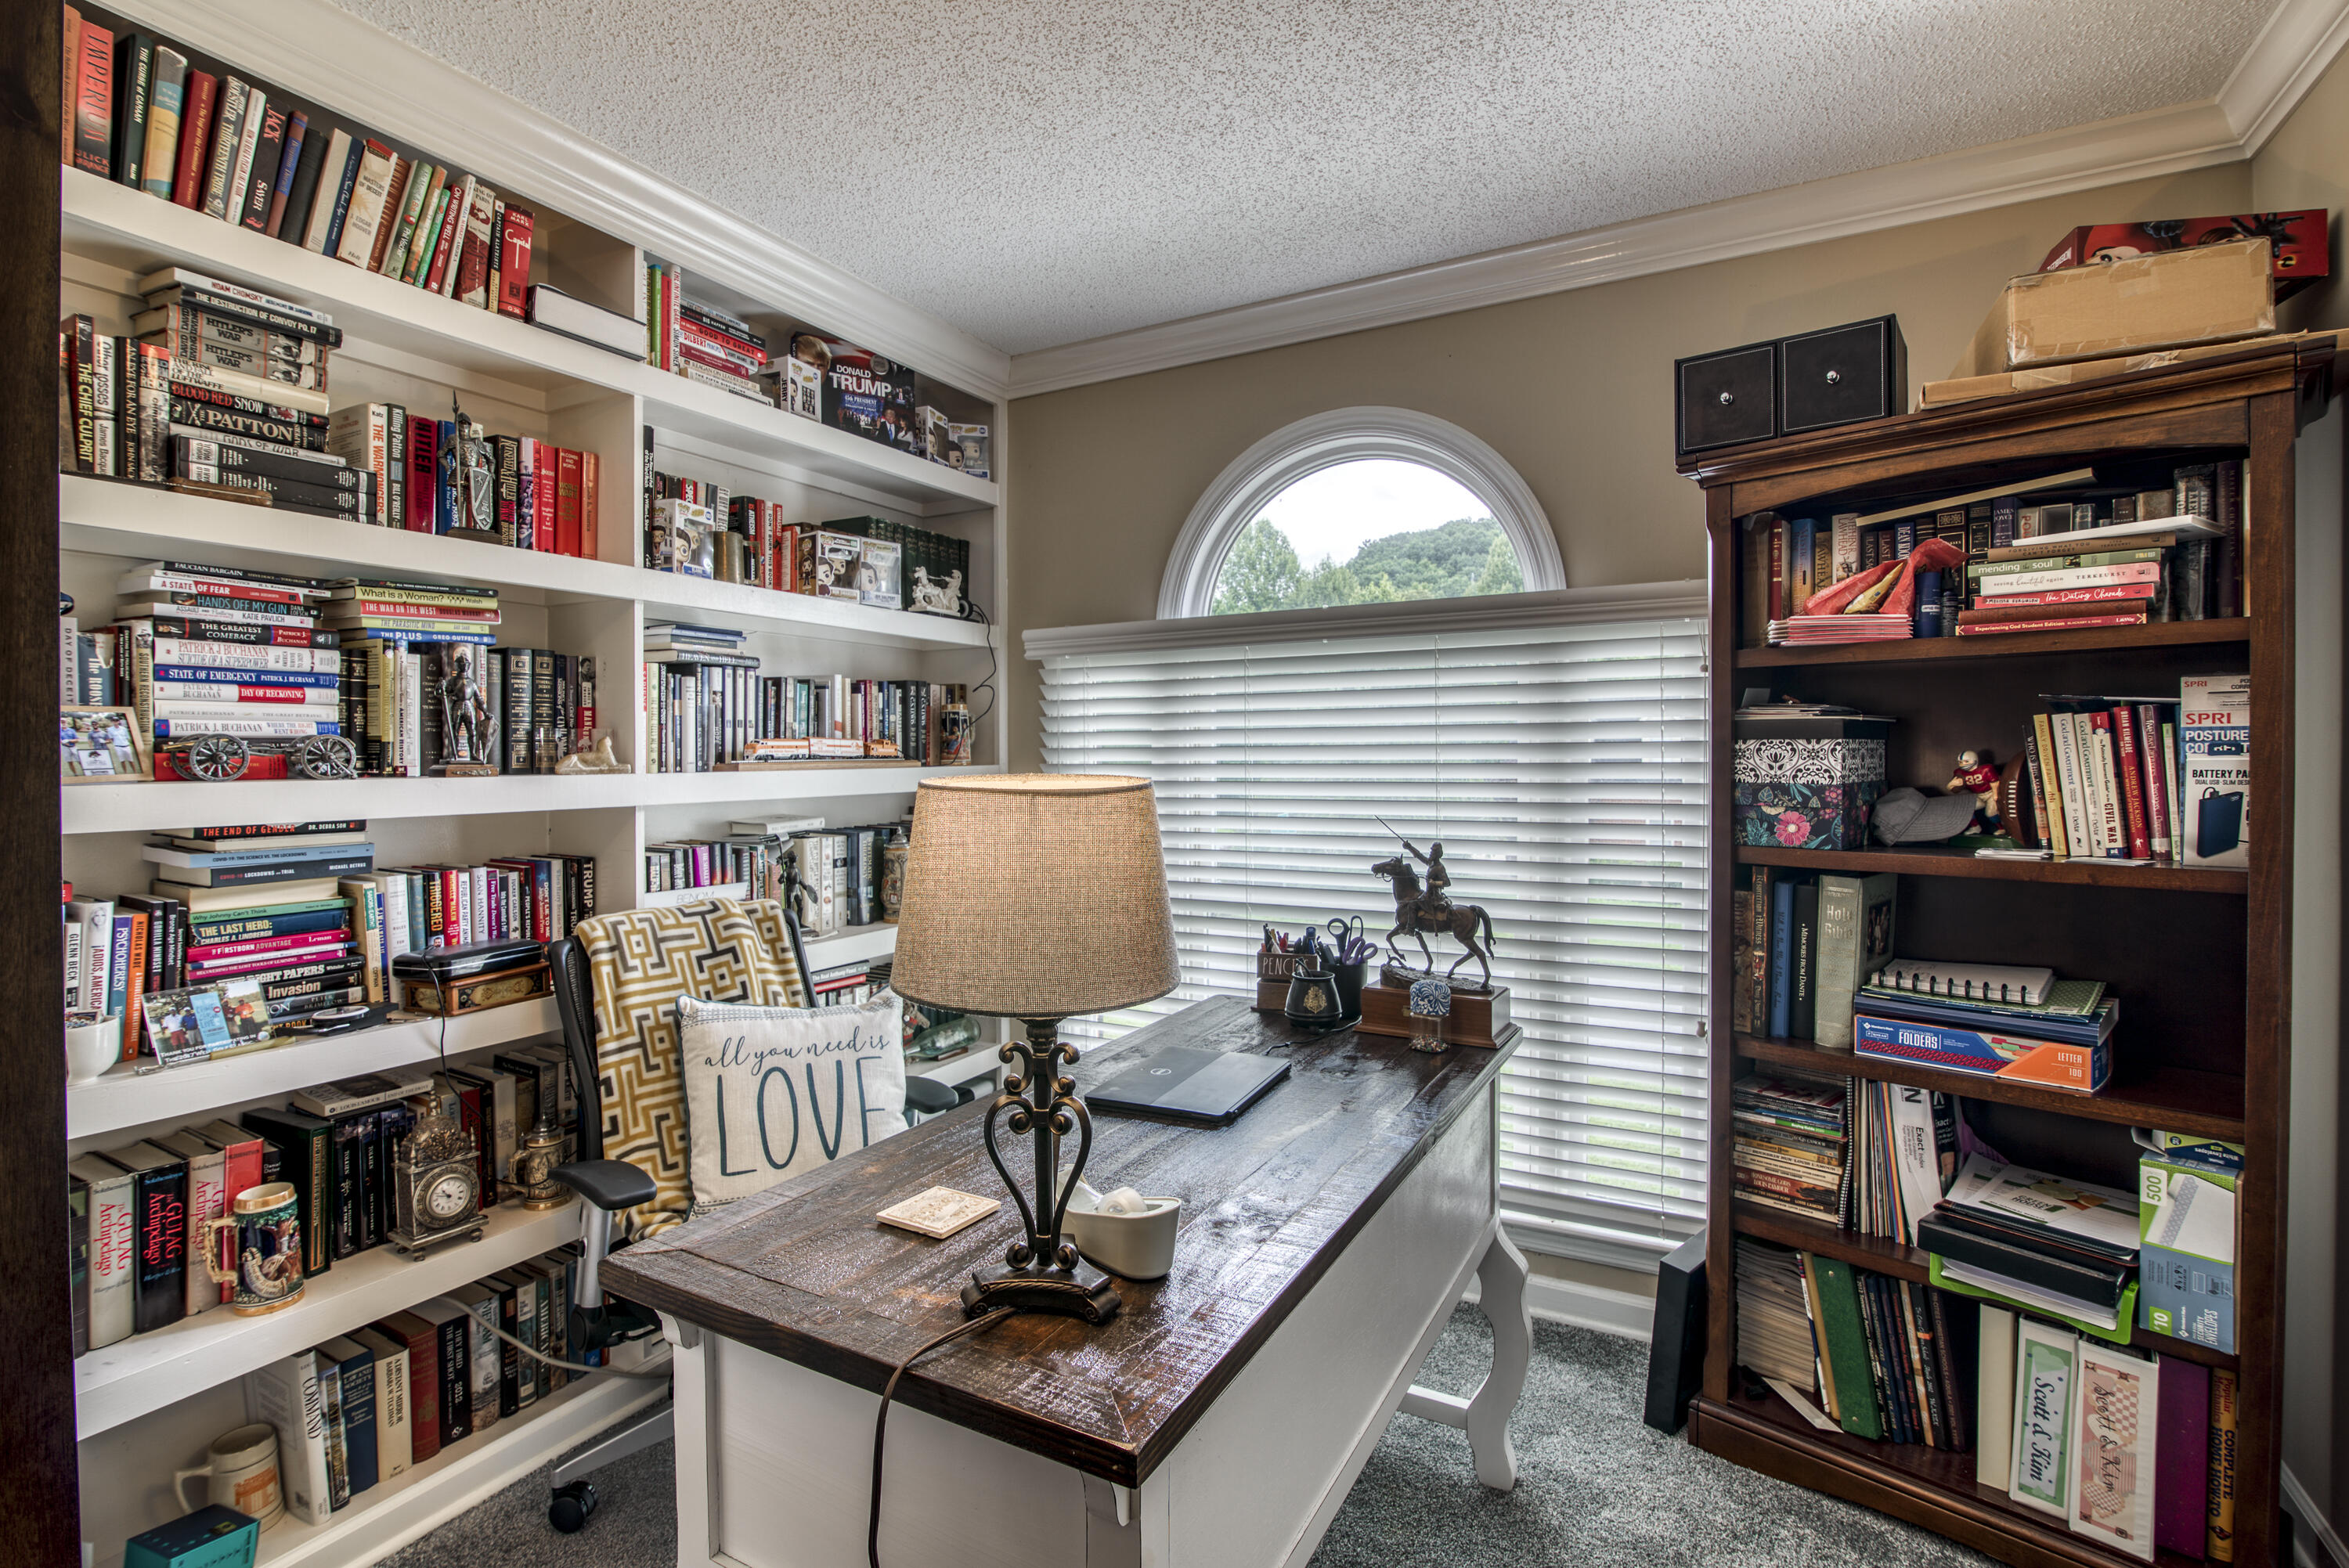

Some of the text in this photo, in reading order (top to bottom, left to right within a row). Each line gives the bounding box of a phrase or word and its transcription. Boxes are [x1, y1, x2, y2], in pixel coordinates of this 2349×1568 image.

[82, 34, 108, 142] IMPERIUM
[263, 103, 287, 143] JACK
[253, 179, 268, 211] SAYER
[443, 187, 463, 241] ON WRITING WELL
[510, 216, 529, 228] MARX
[511, 211, 529, 222] KARL
[505, 229, 531, 269] Capital
[211, 281, 263, 302] NOAM CHOMSKY
[195, 291, 210, 303] THE
[210, 296, 258, 317] DESTRUCTION
[259, 311, 269, 320] OF
[269, 314, 297, 329] CONVOY
[206, 317, 254, 337] HITLER'S
[217, 329, 242, 343] WAR
[684, 332, 706, 348] DILBERT
[698, 327, 755, 355] GOOD TO GREAT
[97, 341, 113, 371] Other
[204, 344, 253, 362] HITLER'S
[216, 355, 241, 368] WAR
[836, 365, 871, 379] DONALD
[828, 373, 892, 398] TRUMP
[171, 382, 263, 413] BLOOD RED SNOW
[853, 396, 877, 406] PRESIDENT
[78, 363, 92, 463] THE CHIEF CULPRIT
[207, 409, 294, 442] PATTON
[391, 408, 402, 458] Killing Patton
[373, 424, 384, 514] THE WARMONGERS
[392, 482, 401, 494] BILL
[1898, 526, 1911, 544] DEAN
[1978, 562, 2020, 575] mending
[2032, 560, 2053, 570] soul
[2076, 571, 2127, 580] TERKEURST
[169, 582, 193, 590] STATE
[207, 586, 230, 595] FEAR
[360, 589, 386, 597] What
[405, 592, 444, 602] Woman?
[2044, 587, 2127, 603] The Dating Charade
[197, 596, 287, 615] HANDS OFF MY GUN
[366, 603, 378, 611] THE
[420, 607, 437, 615] WEST
[219, 624, 262, 633] GREATEST
[260, 615, 285, 623] PAVLICH
[207, 631, 256, 640] COMEBACK
[395, 632, 422, 640] PLUS
[169, 669, 257, 682] STATE OF EMERGENCY
[139, 653, 150, 733] SOUTHERN RECONSTRUCTION
[241, 689, 254, 697] DAY
[265, 690, 304, 699] RECKONING
[175, 723, 263, 733] PATRICK BUCHANAN
[2120, 711, 2130, 726] BRIAN
[2185, 712, 2232, 725] SPRI
[2185, 730, 2249, 741] POSTURE
[1965, 774, 1984, 785] 32
[2192, 769, 2233, 779] BATTERY
[2128, 766, 2143, 828] ANDREW JACKSON
[204, 824, 295, 837] THE END OF GENDER
[2104, 802, 2117, 844] CIVIL WAR
[583, 861, 594, 907] TRUMP
[208, 911, 231, 921] Johnny
[429, 879, 443, 932] TRIGGERED
[1826, 903, 1853, 921] Holy
[476, 899, 485, 935] HANNITY
[199, 920, 272, 937] THE LAST HERO:
[201, 930, 272, 946] CHARLES LINDBERGH
[1824, 923, 1854, 939] Bible
[132, 921, 144, 969] NICHOLAS WADE
[1800, 928, 1809, 959] MEMORIES
[67, 933, 80, 981] GLENN BECK
[113, 928, 128, 992] PSYCHOHERESY
[1262, 956, 1308, 976] PENCI
[283, 964, 325, 979] PAPERS
[90, 976, 104, 1010] AMERICA
[268, 982, 321, 999] Invasion
[705, 1026, 889, 1076] all you need is
[1899, 1032, 1938, 1049] FOLDERS
[2057, 1051, 2083, 1064] LETTER
[2069, 1068, 2082, 1078] 100
[717, 1056, 886, 1177] LOVE
[1915, 1126, 1925, 1153] Exact
[2145, 1174, 2162, 1202] 500
[143, 1192, 165, 1265] Archipelago
[165, 1202, 183, 1259] GULAG
[93, 1203, 116, 1277] Archipelago
[117, 1212, 132, 1271] GULAG
[2204, 1309, 2218, 1346] ENVELOPES
[2033, 1376, 2055, 1422] Scott
[2222, 1376, 2234, 1415] Popular
[302, 1377, 322, 1439] COMMAND
[2093, 1381, 2119, 1433] Scott
[2212, 1426, 2223, 1462] HOME
[2030, 1441, 2053, 1482] Kim
[2222, 1429, 2235, 1501] COMPLETE
[2098, 1454, 2122, 1493] Kim
